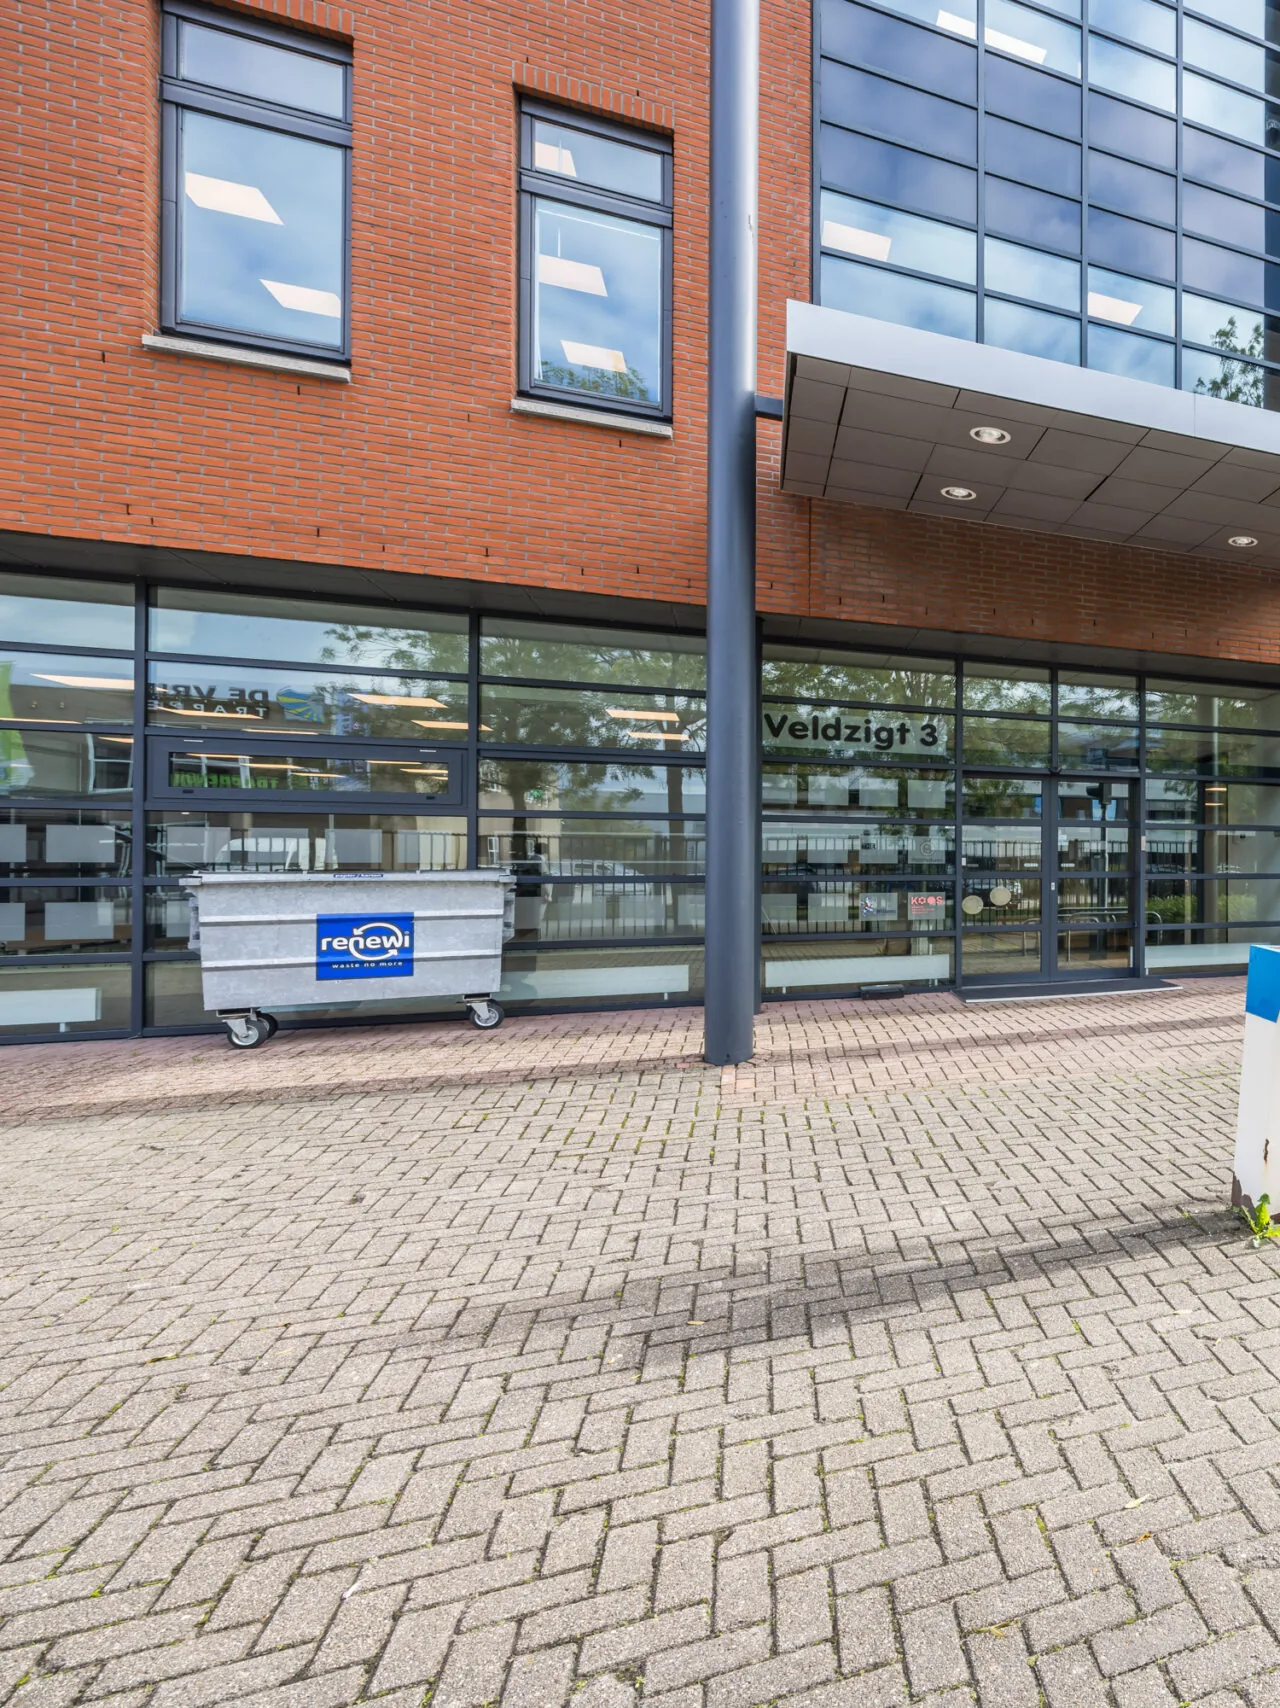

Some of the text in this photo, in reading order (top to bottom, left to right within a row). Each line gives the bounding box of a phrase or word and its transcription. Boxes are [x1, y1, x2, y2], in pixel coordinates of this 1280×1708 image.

[764, 713, 938, 750] Veldzigt 3
[321, 926, 410, 957] renewi
